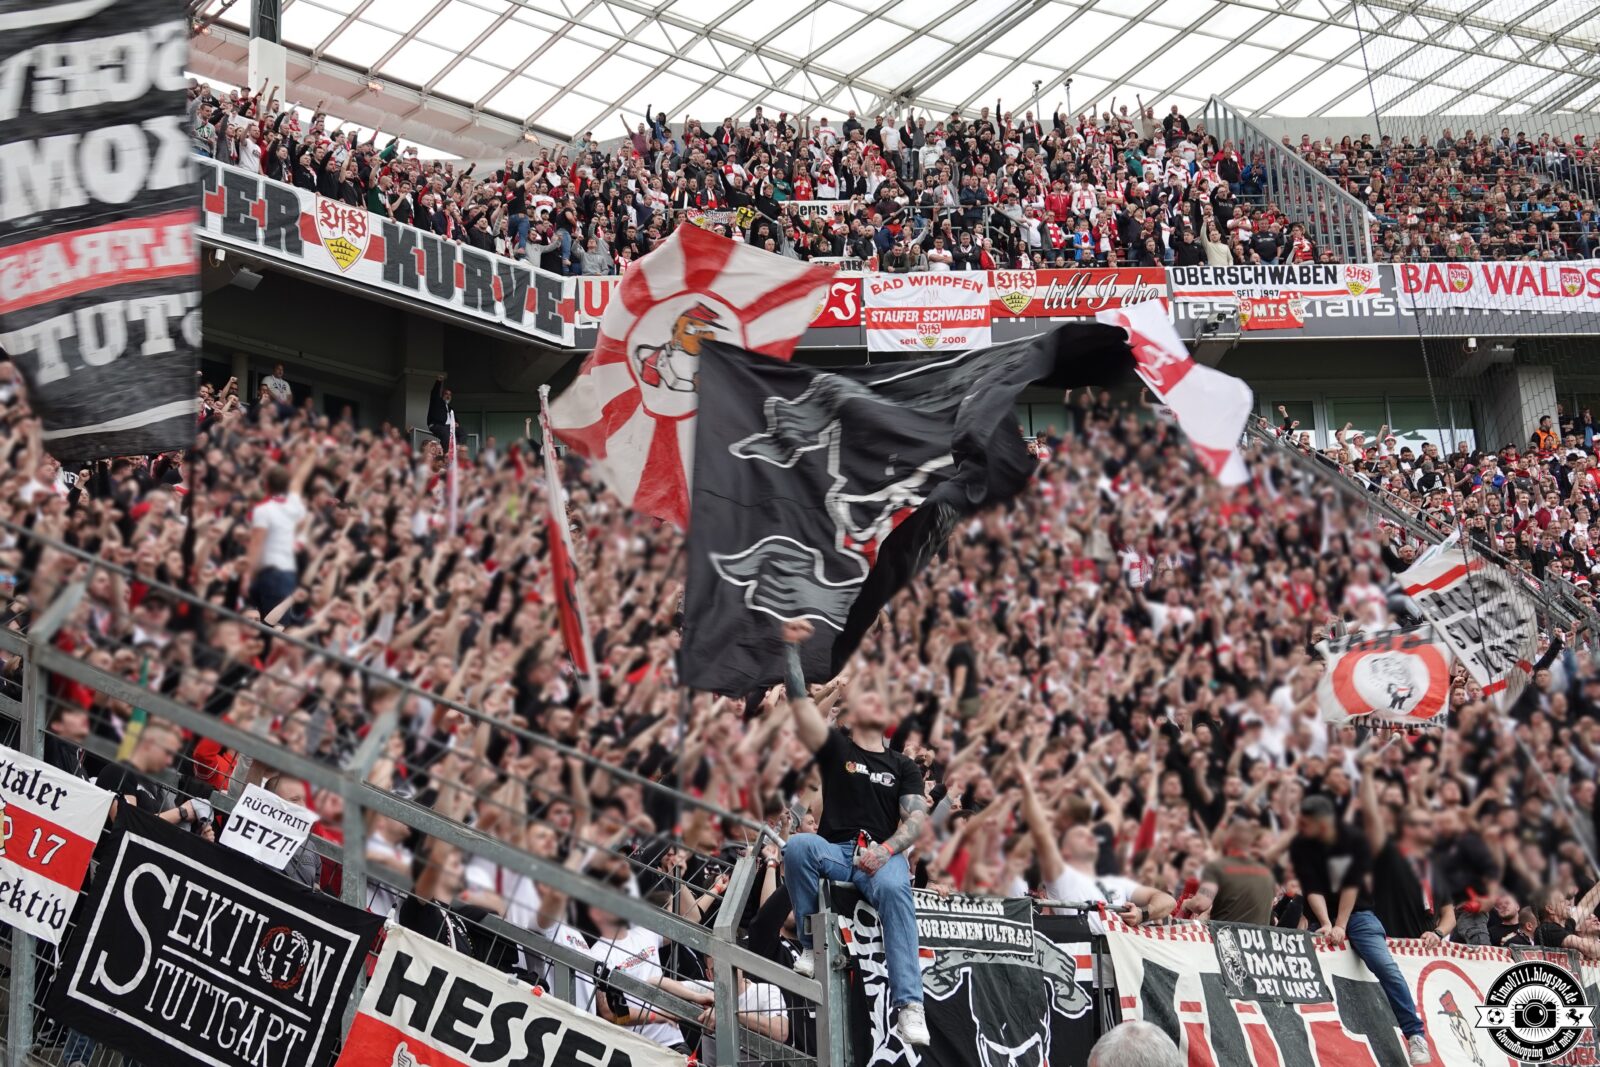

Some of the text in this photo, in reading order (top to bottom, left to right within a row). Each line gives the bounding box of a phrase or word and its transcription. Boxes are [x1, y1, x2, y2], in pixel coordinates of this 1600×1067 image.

[381, 219, 564, 338] KURVE
[870, 275, 983, 296] BAD WIMPFEN
[1173, 265, 1338, 285] OBERSCHWABEN
[1400, 263, 1473, 293] BAD
[1043, 272, 1092, 311] till
[871, 308, 985, 323] STAUFER SCHWABEN
[1253, 303, 1288, 317] MTS
[942, 336, 967, 344] 2008
[0, 759, 67, 811] taler
[242, 796, 309, 832] RÜCKTRITT
[228, 814, 298, 856] JETZT!
[913, 891, 949, 912] HRE
[985, 923, 1032, 948] ULTRAS
[1238, 928, 1306, 954] DU BIST
[1244, 951, 1316, 980] IMMER
[1282, 980, 1322, 999] UNS!
